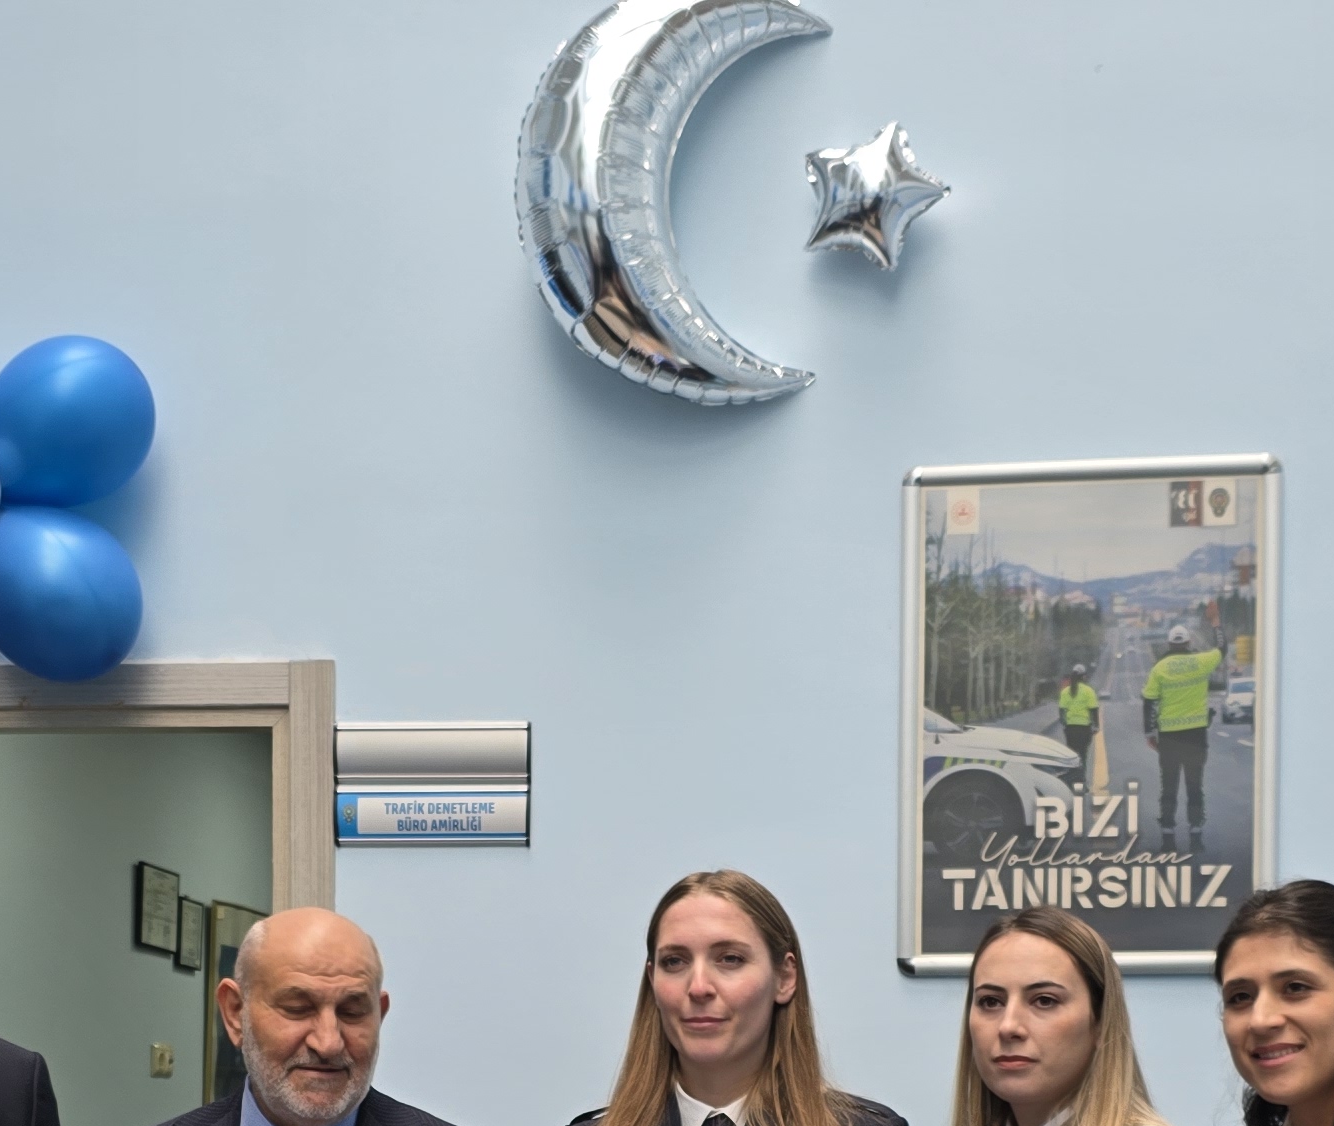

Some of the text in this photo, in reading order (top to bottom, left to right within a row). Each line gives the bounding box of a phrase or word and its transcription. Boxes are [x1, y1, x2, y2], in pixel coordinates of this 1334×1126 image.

[384, 800, 495, 814] TRAFİK DENETLEME
[397, 816, 482, 831] BÜRO AMİRLİĞİ
[1034, 782, 1139, 839] BİZİ
[980, 832, 1193, 882] Yollardan
[942, 864, 1232, 911] TANIRSINIZ
